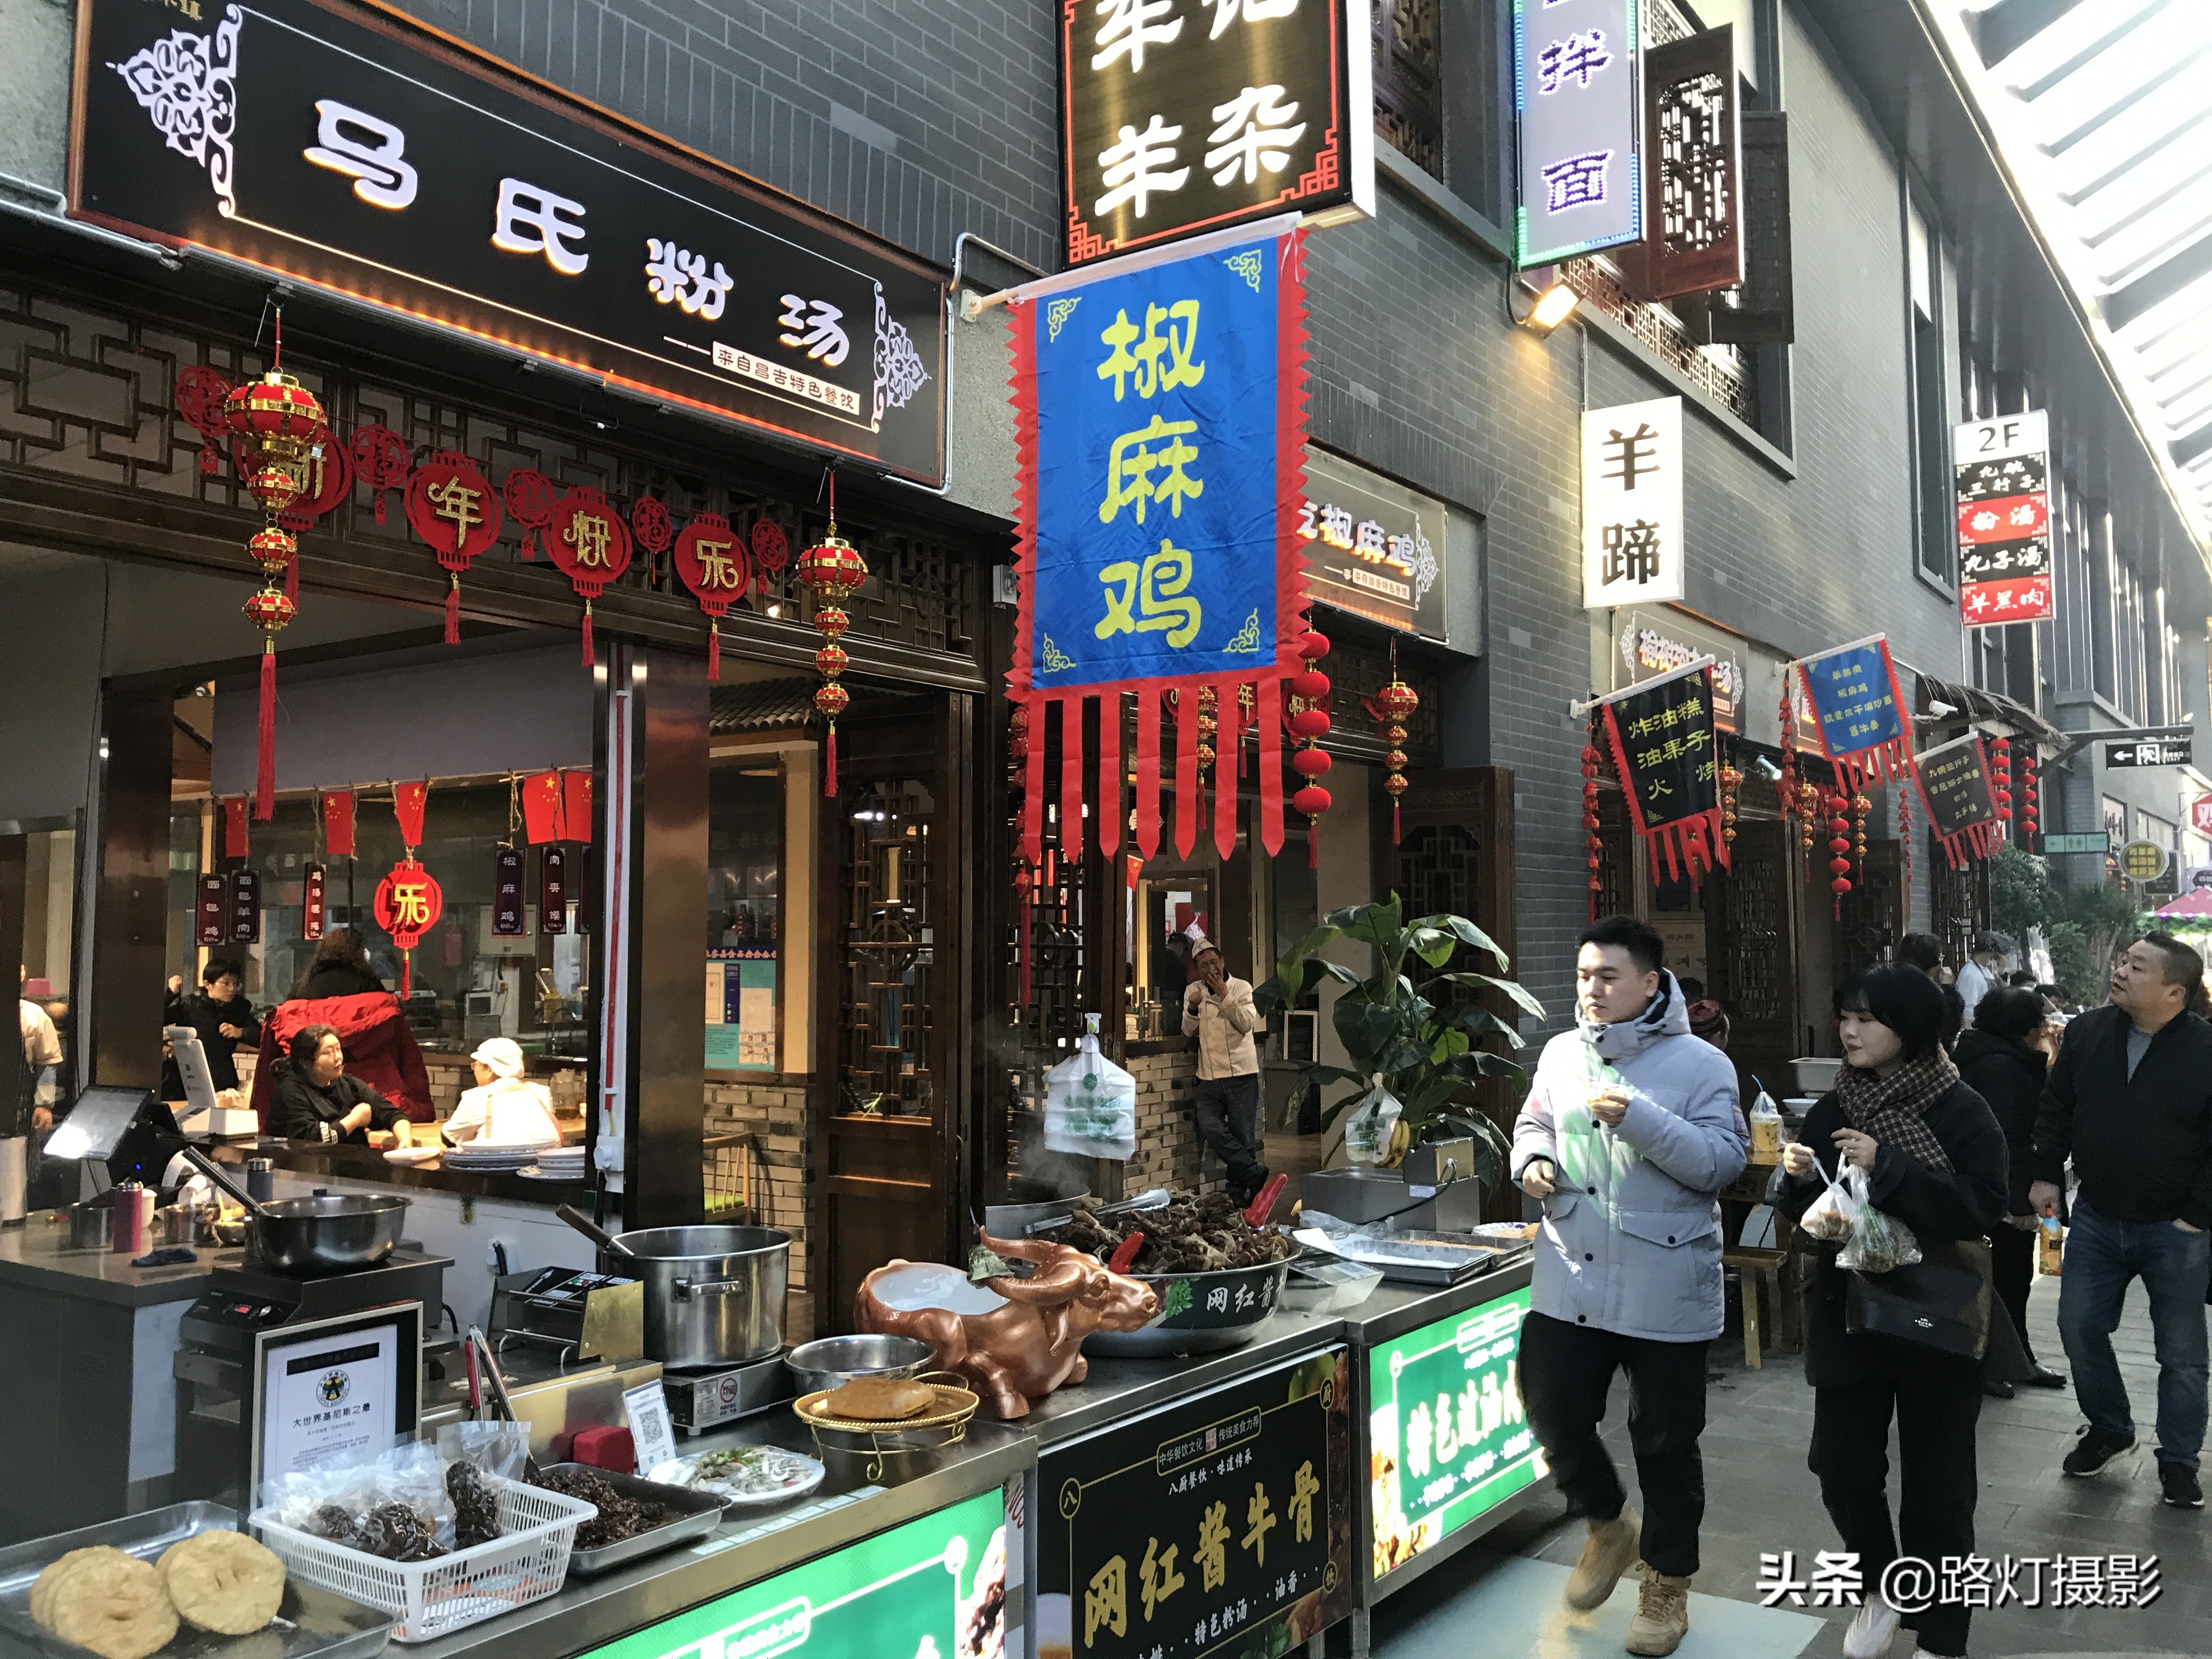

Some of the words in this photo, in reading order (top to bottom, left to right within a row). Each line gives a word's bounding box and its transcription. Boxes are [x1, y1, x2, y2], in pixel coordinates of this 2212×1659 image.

[1095, 84, 1306, 218] 羊杂
[303, 99, 850, 367] 马氏粉汤
[718, 349, 854, 409] 来自昌吉特色餐饮
[1979, 422, 2019, 452] 2F
[1095, 299, 1205, 648] 椒麻鸡
[1600, 423, 1661, 586] 羊蹄
[1967, 588, 2044, 614] 羊羔肉
[1628, 697, 1705, 739] 炸油糕
[1637, 730, 1711, 769] 油果子
[500, 856, 517, 921] 椒麻鸡
[292, 1402, 370, 1427] 大世界基尼斯之最
[1159, 1437, 1203, 1465] 中华餐饮文化
[1218, 1415, 1259, 1442] 传统美食力荐
[1084, 1460, 1319, 1648] 网红酱牛骨
